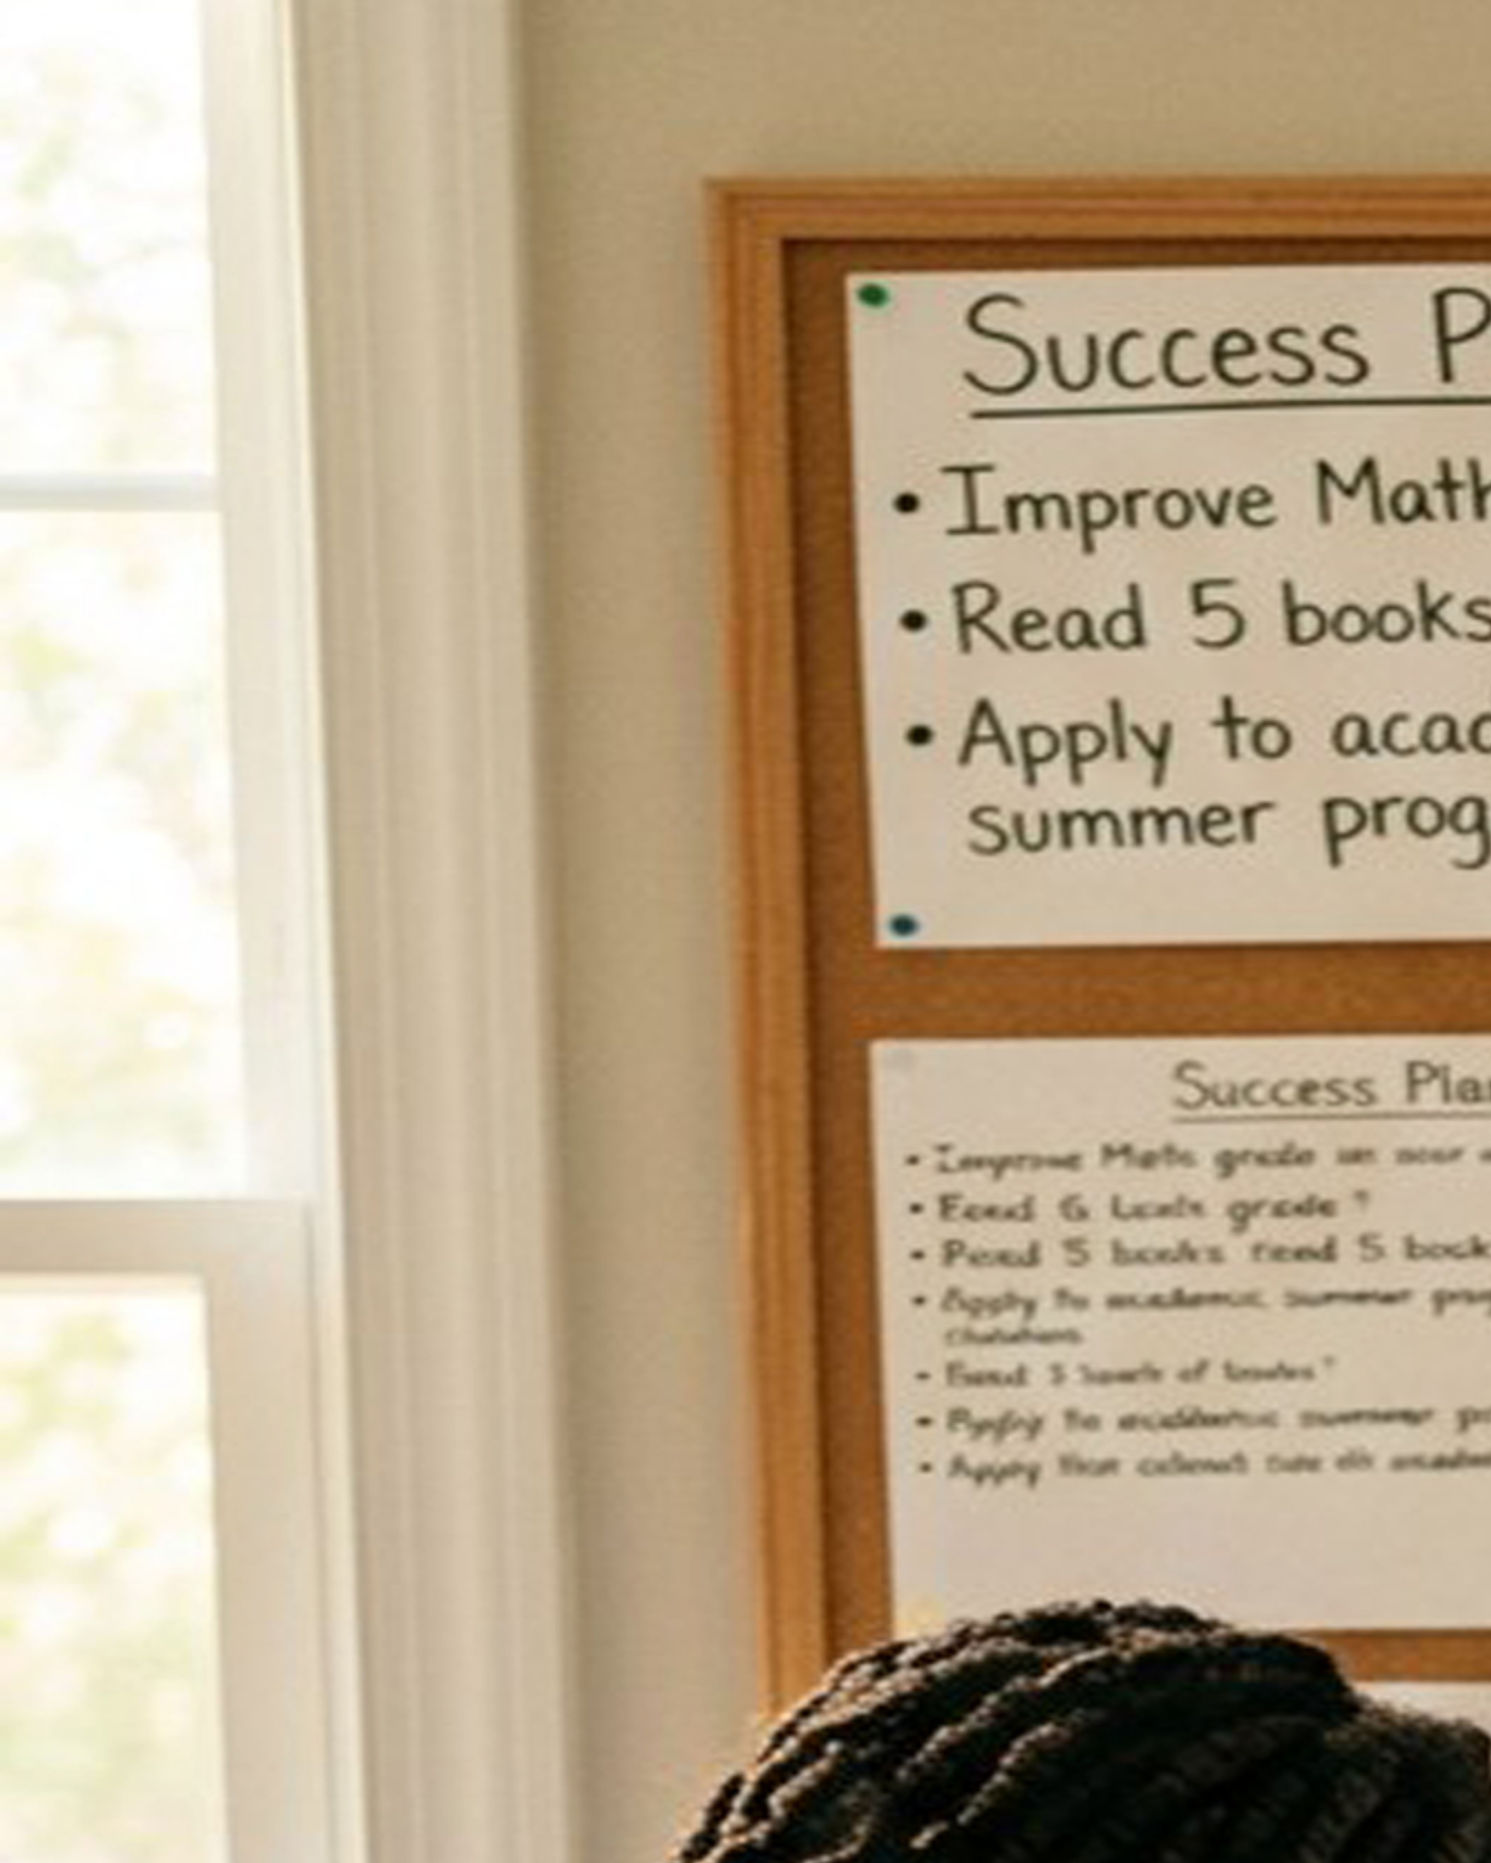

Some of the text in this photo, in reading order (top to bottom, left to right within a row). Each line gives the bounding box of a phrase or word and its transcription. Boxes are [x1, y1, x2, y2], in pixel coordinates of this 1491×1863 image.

[963, 293, 1372, 397] Success
[941, 463, 1277, 555] Improve
[950, 579, 1146, 655] Read
[1190, 577, 1247, 650] 5
[957, 696, 1174, 789] Apply
[1212, 695, 1293, 760] to
[967, 801, 1275, 856] summer
[1172, 1058, 1379, 1111] Success
